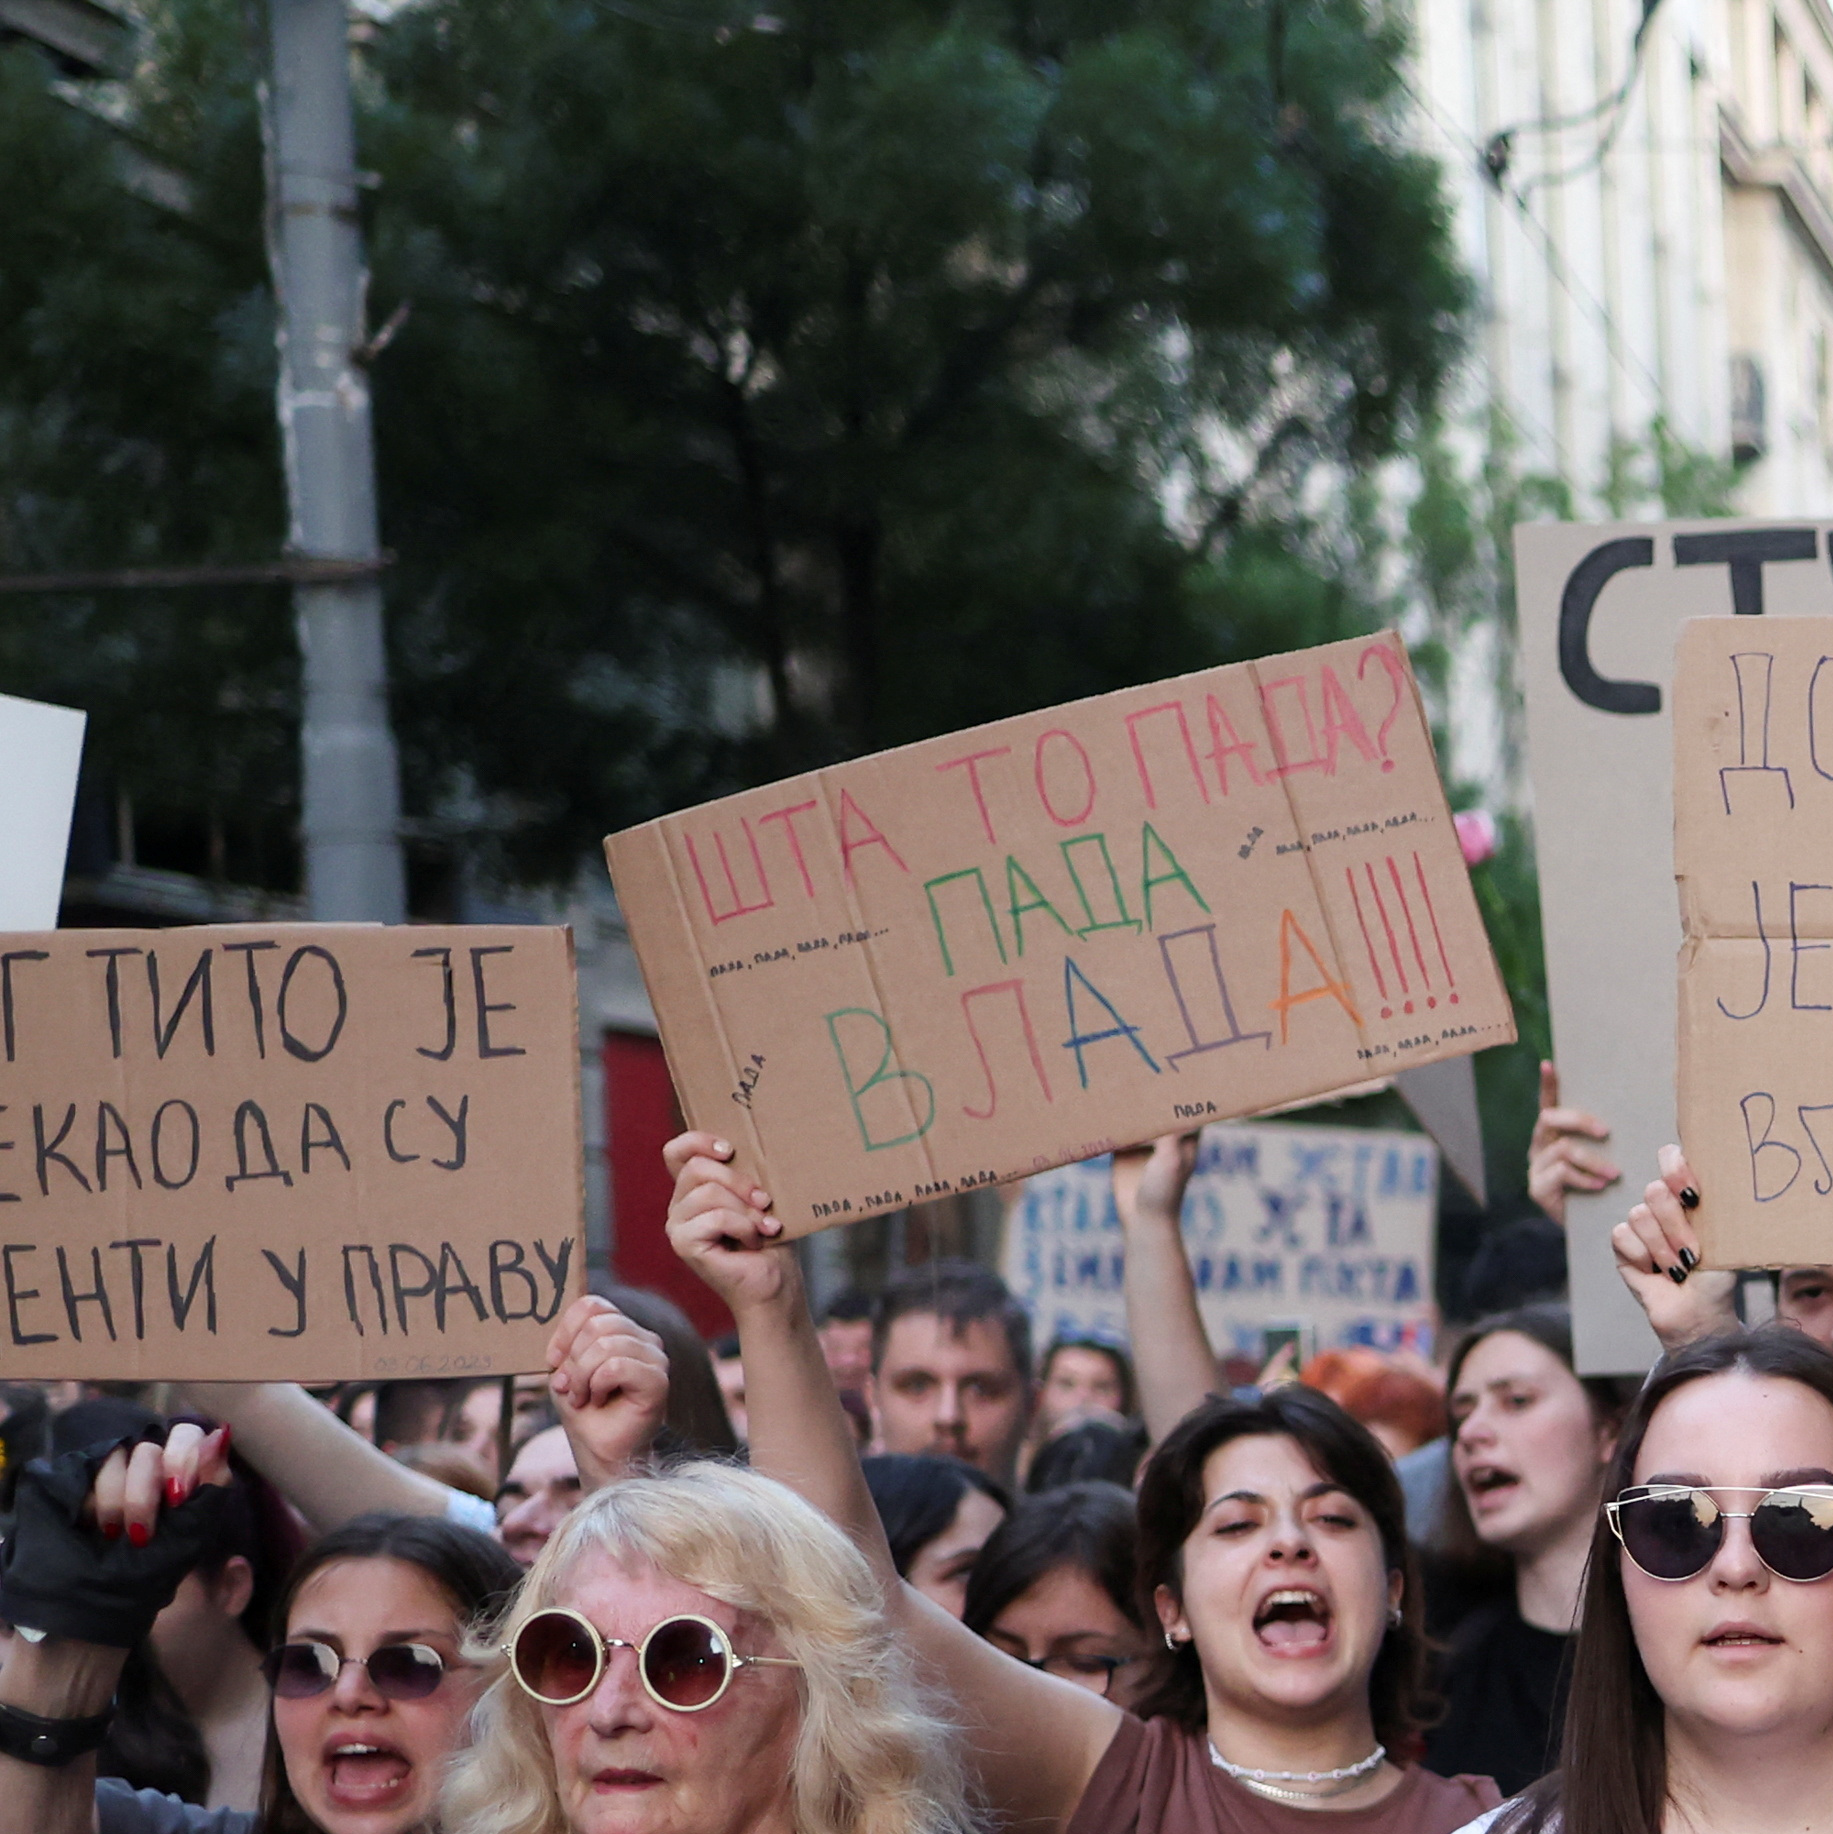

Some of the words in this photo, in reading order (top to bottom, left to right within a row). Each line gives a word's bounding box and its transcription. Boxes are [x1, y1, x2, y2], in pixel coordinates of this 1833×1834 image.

[684, 788, 909, 926] ШТА
[935, 729, 1097, 846] ТО
[1124, 643, 1406, 810] ПАДА?
[924, 821, 1211, 977] ПАДА
[86, 940, 348, 1063] ТИТО
[410, 945, 526, 1062] ЈЕ
[383, 1095, 469, 1171] СУ
[262, 1247, 306, 1338] У
[341, 1237, 575, 1337] ПРАВУ
